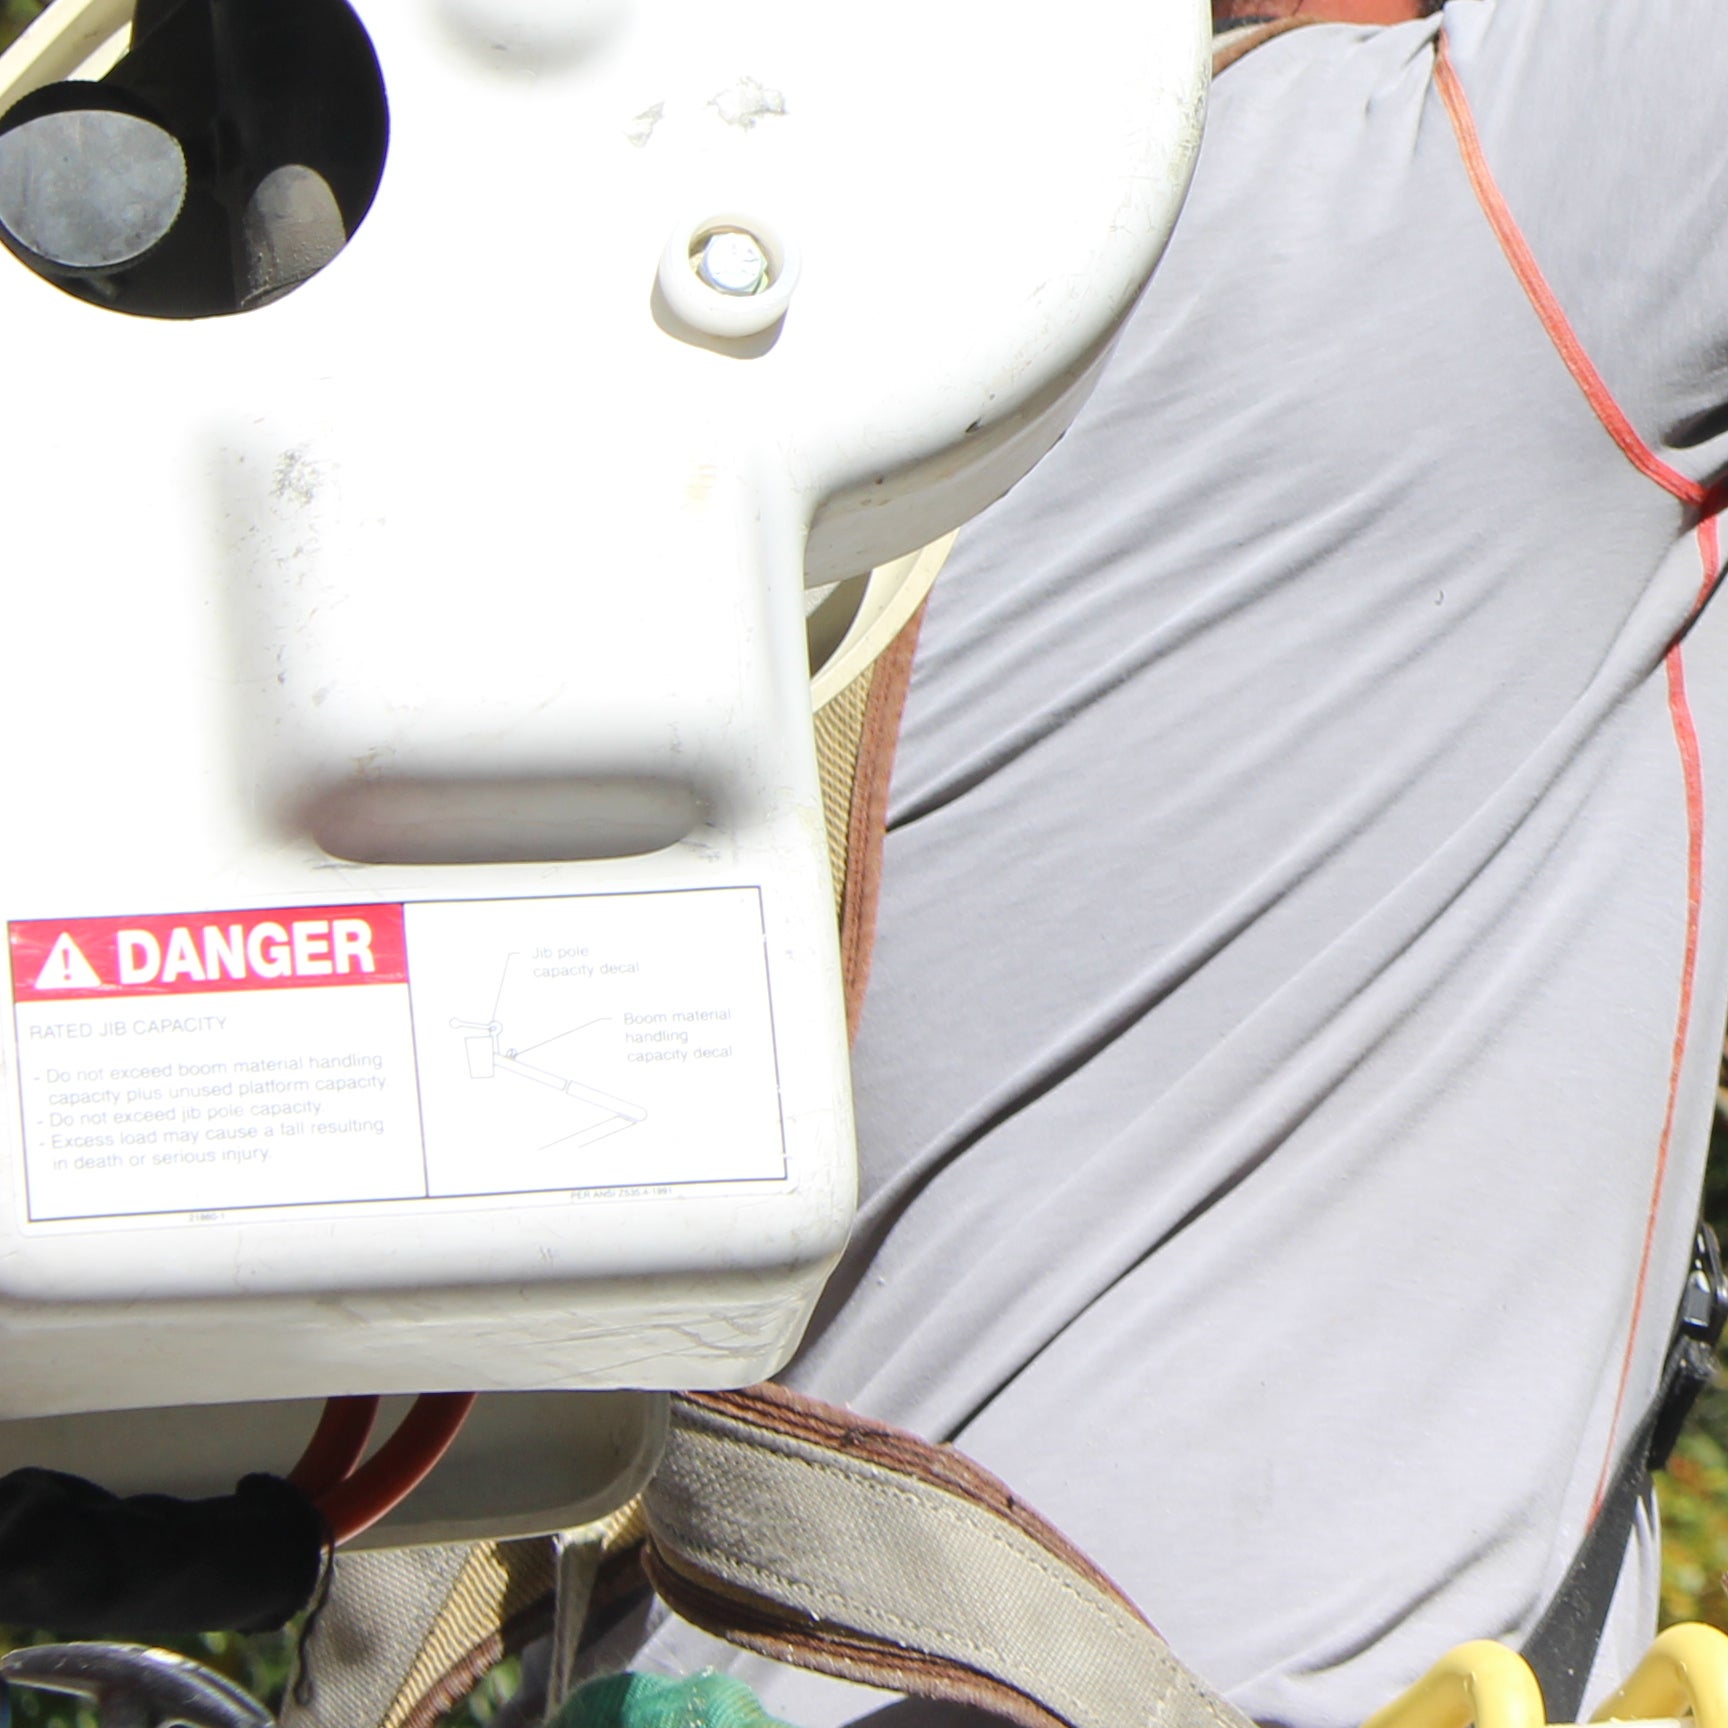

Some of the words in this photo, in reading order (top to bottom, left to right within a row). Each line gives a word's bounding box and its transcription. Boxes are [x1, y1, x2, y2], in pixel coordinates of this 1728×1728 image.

[117, 919, 375, 984] DANGER
[531, 946, 553, 960] Jib
[557, 945, 590, 960] pole
[533, 964, 594, 979] capacity
[600, 961, 640, 975] decal
[624, 1012, 667, 1025] Boom
[672, 1008, 731, 1022] material
[29, 1023, 93, 1040] RATED
[99, 1021, 128, 1037] JIB
[132, 1016, 227, 1036] CAPACITY
[625, 1028, 688, 1044] handling
[627, 1047, 688, 1063] capacity
[693, 1045, 733, 1060] decal
[46, 1068, 71, 1084] Do
[76, 1067, 105, 1082] not
[109, 1064, 173, 1081] exceed
[177, 1062, 228, 1078] boom
[233, 1056, 304, 1073] material
[309, 1053, 383, 1070] handling
[48, 1089, 121, 1108] capacity
[126, 1086, 163, 1104] plus
[168, 1082, 234, 1099] unused
[238, 1079, 310, 1098] platform
[49, 1112, 74, 1128] Do
[80, 1111, 107, 1126] not
[112, 1107, 177, 1124] exceed
[181, 1105, 201, 1123] jib
[207, 1102, 244, 1121] pole
[51, 1133, 115, 1150] Excess
[120, 1129, 158, 1145] load
[163, 1129, 200, 1146] may
[204, 1126, 258, 1141] cause
[263, 1125, 275, 1138] a
[311, 1118, 384, 1135] resulting
[53, 1156, 68, 1170] in
[74, 1153, 123, 1170] death
[128, 1154, 145, 1167] or
[153, 1149, 216, 1166] serious
